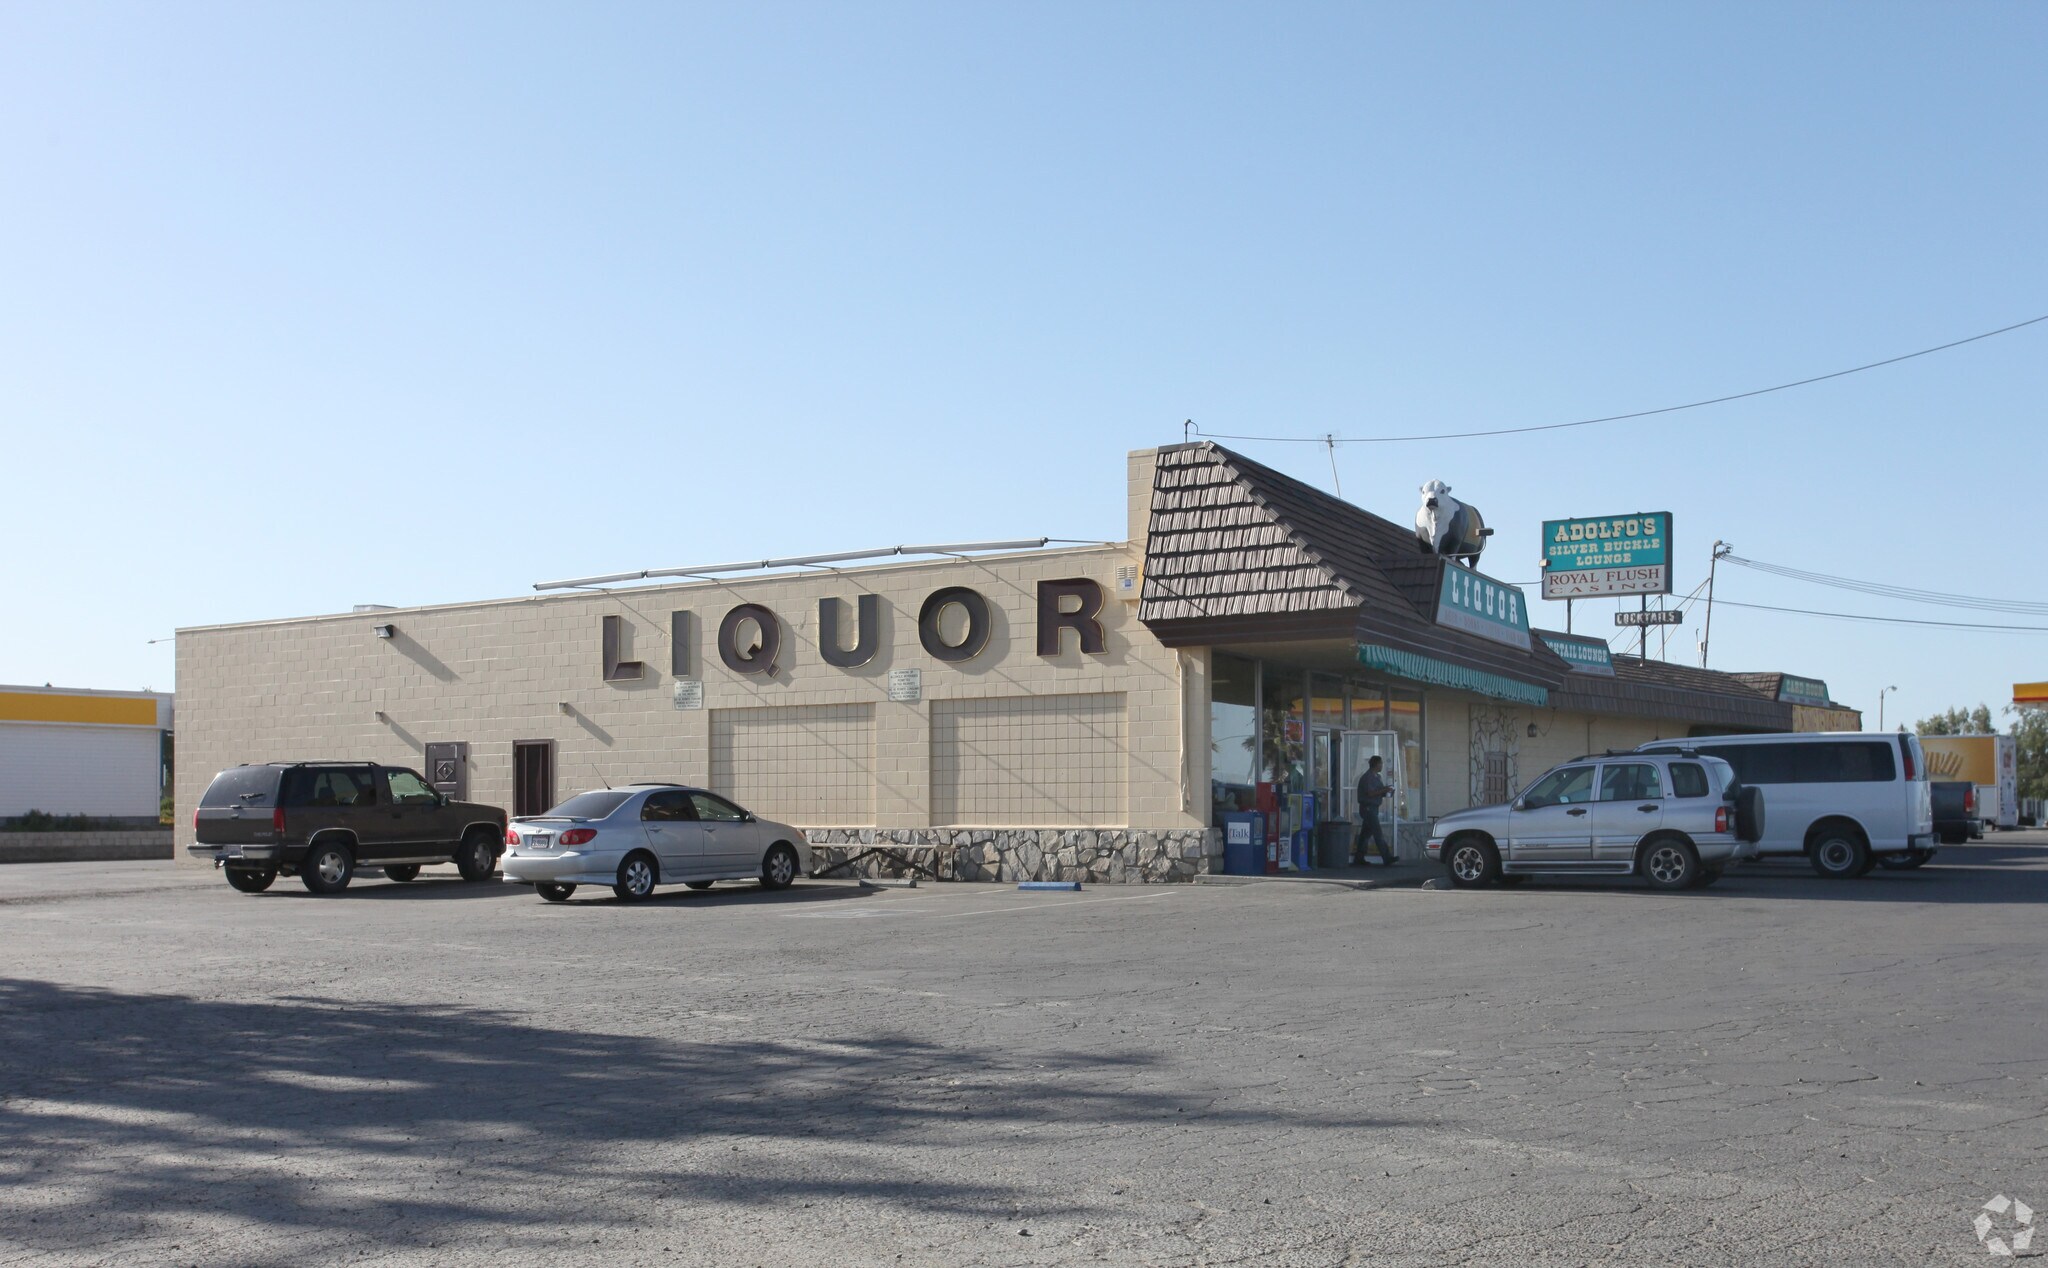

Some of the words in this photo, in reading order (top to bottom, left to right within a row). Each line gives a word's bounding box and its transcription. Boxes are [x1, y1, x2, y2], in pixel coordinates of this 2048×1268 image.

[1554, 518, 1656, 542] ADOLFO'S
[1549, 543, 1599, 556] SILVER
[1604, 538, 1660, 552] BUCKLE
[1576, 553, 1632, 566] LOUNGE
[1549, 572, 1599, 585] ROYAL
[1606, 568, 1660, 582] FLUSH
[1549, 582, 1659, 594] CASINO
[1451, 571, 1518, 624] LIQUOR
[1616, 612, 1675, 624] COCKTAILS
[602, 577, 1109, 682] LIQUOR
[1578, 646, 1608, 663] LOUNGE
